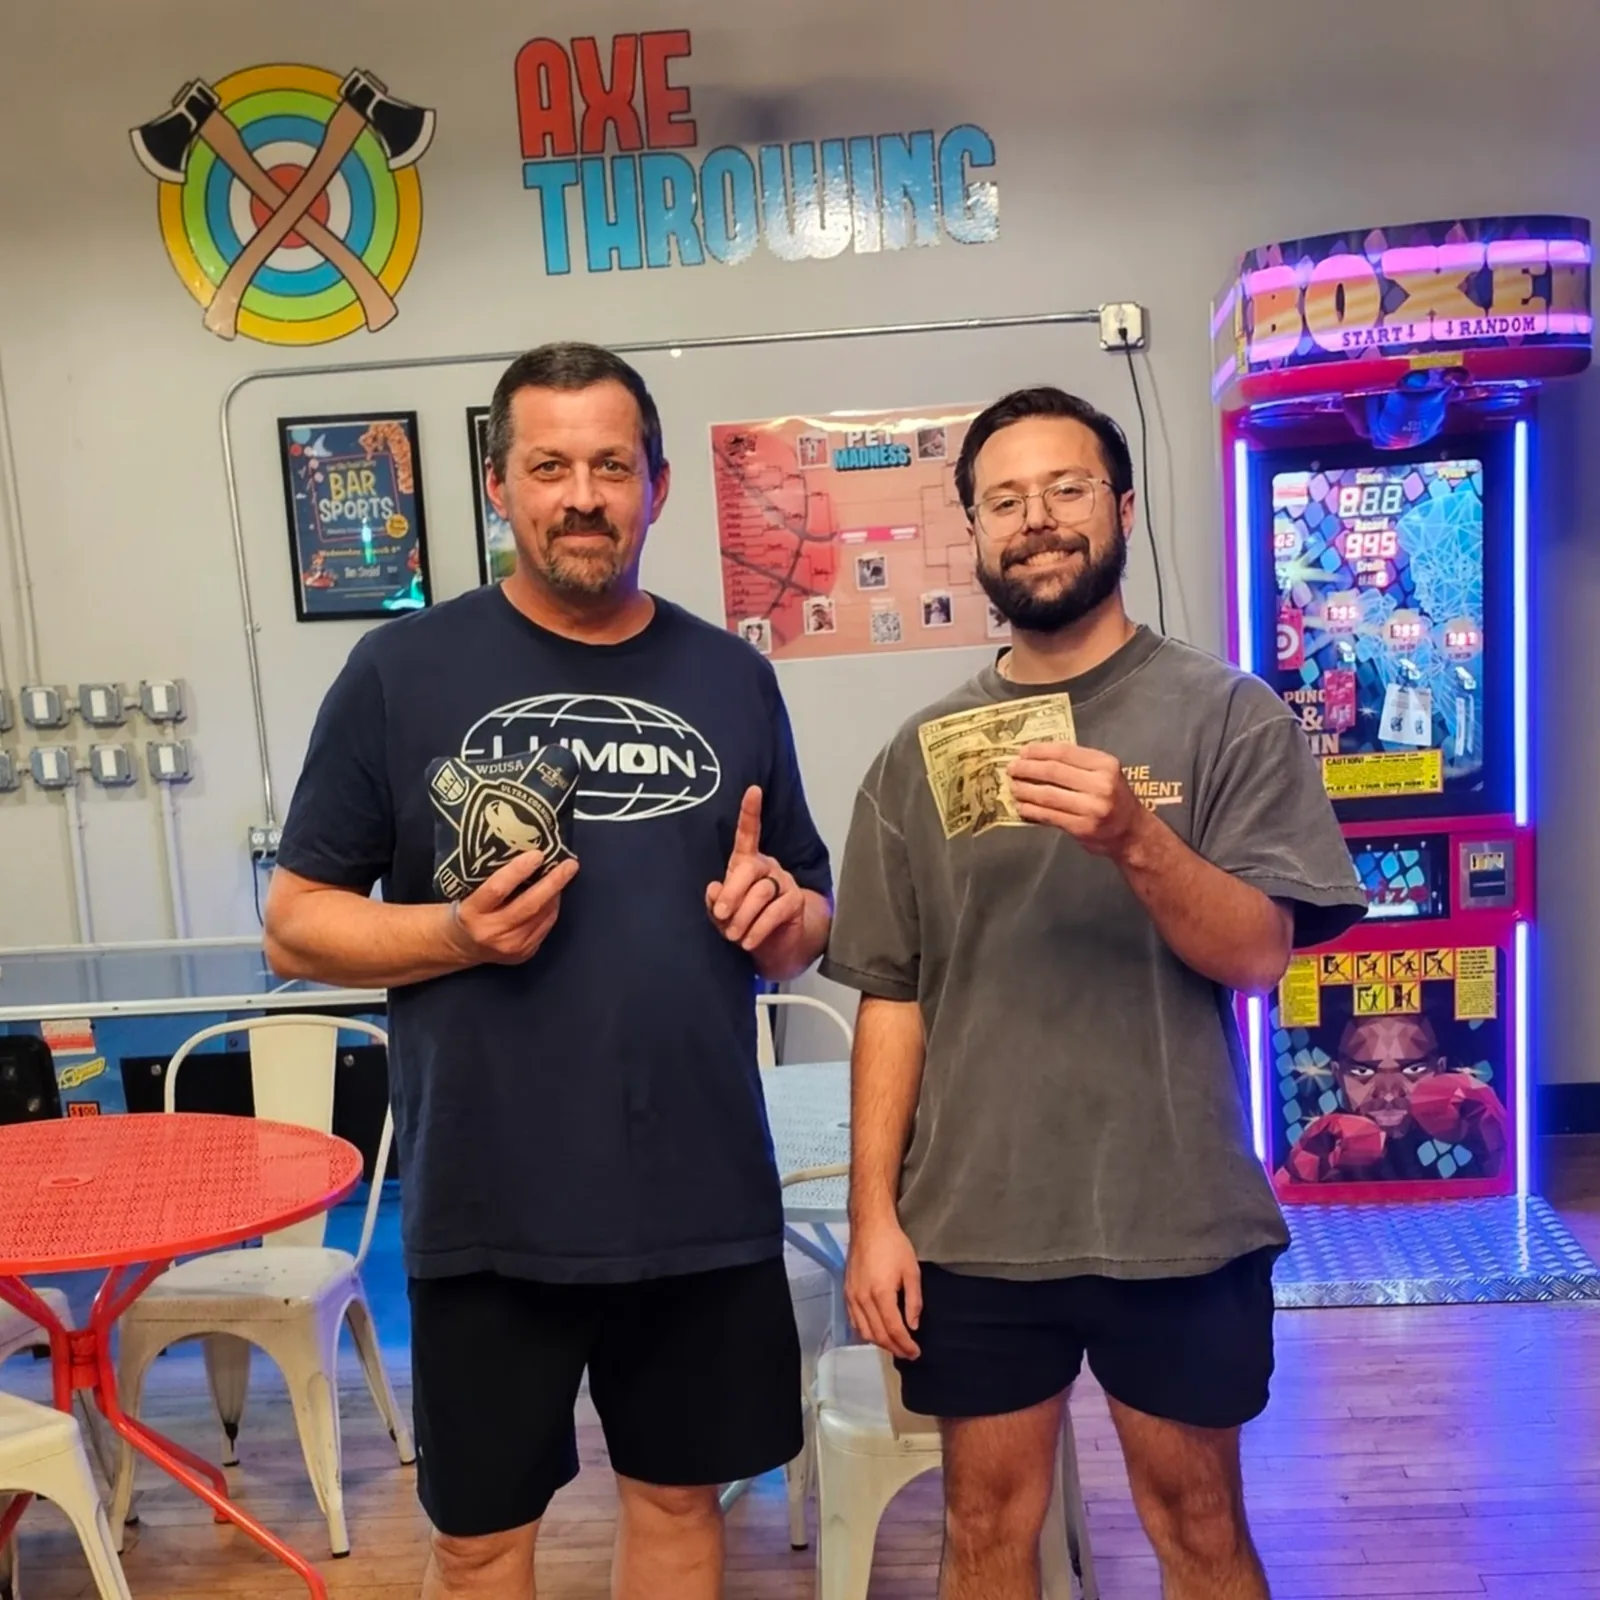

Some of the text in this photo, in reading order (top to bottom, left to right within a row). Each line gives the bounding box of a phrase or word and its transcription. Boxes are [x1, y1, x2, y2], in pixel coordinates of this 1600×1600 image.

[514, 29, 697, 159] AXE
[522, 123, 1000, 275] THROWING
[1342, 317, 1536, 347] START RANDOM
[845, 430, 892, 447] PET
[833, 444, 911, 472] MADNESS
[328, 469, 377, 502] BAR
[318, 496, 394, 524] SPORTS
[1283, 688, 1326, 704] PUNC
[1301, 705, 1323, 732] &
[1310, 733, 1340, 754] IN
[475, 759, 525, 775] WDUSA
[1121, 765, 1151, 780] THE
[500, 784, 528, 801] ULTRA
[1128, 781, 1183, 796] MENT
[440, 869, 467, 896] ULT
